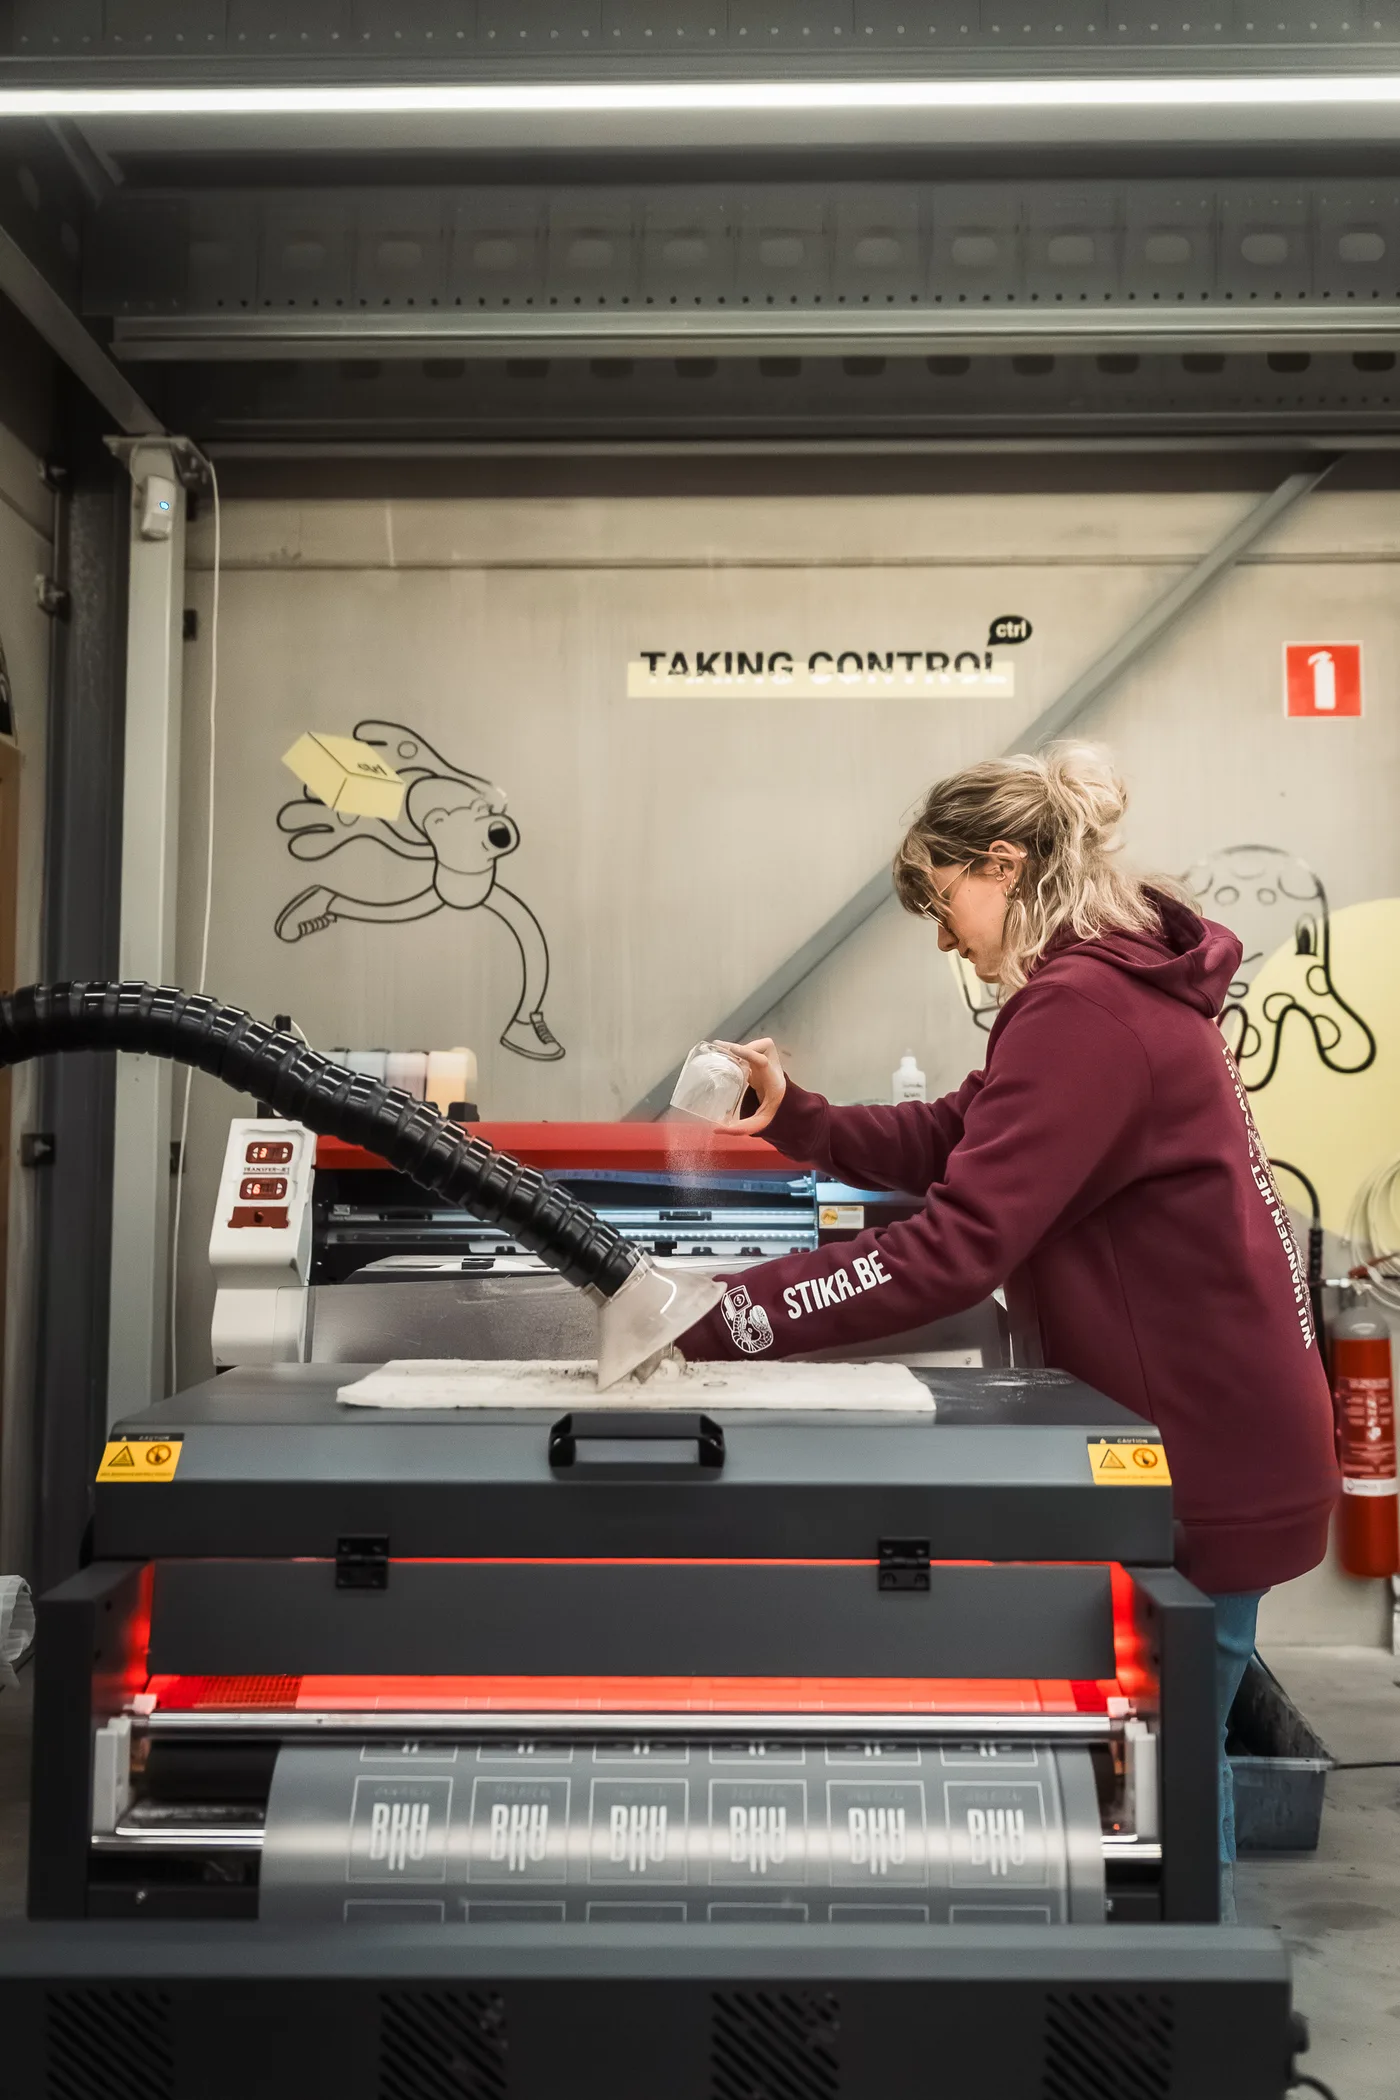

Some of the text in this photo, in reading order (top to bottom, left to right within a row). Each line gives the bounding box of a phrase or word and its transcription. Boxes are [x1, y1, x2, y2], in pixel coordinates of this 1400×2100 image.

[995, 621, 1027, 638] ctrl
[640, 651, 1008, 685] TAKING CONTROL
[1251, 1164, 1276, 1206] HET
[1270, 1208, 1304, 1304] HANGEN
[782, 1249, 893, 1320] STIKR.BE
